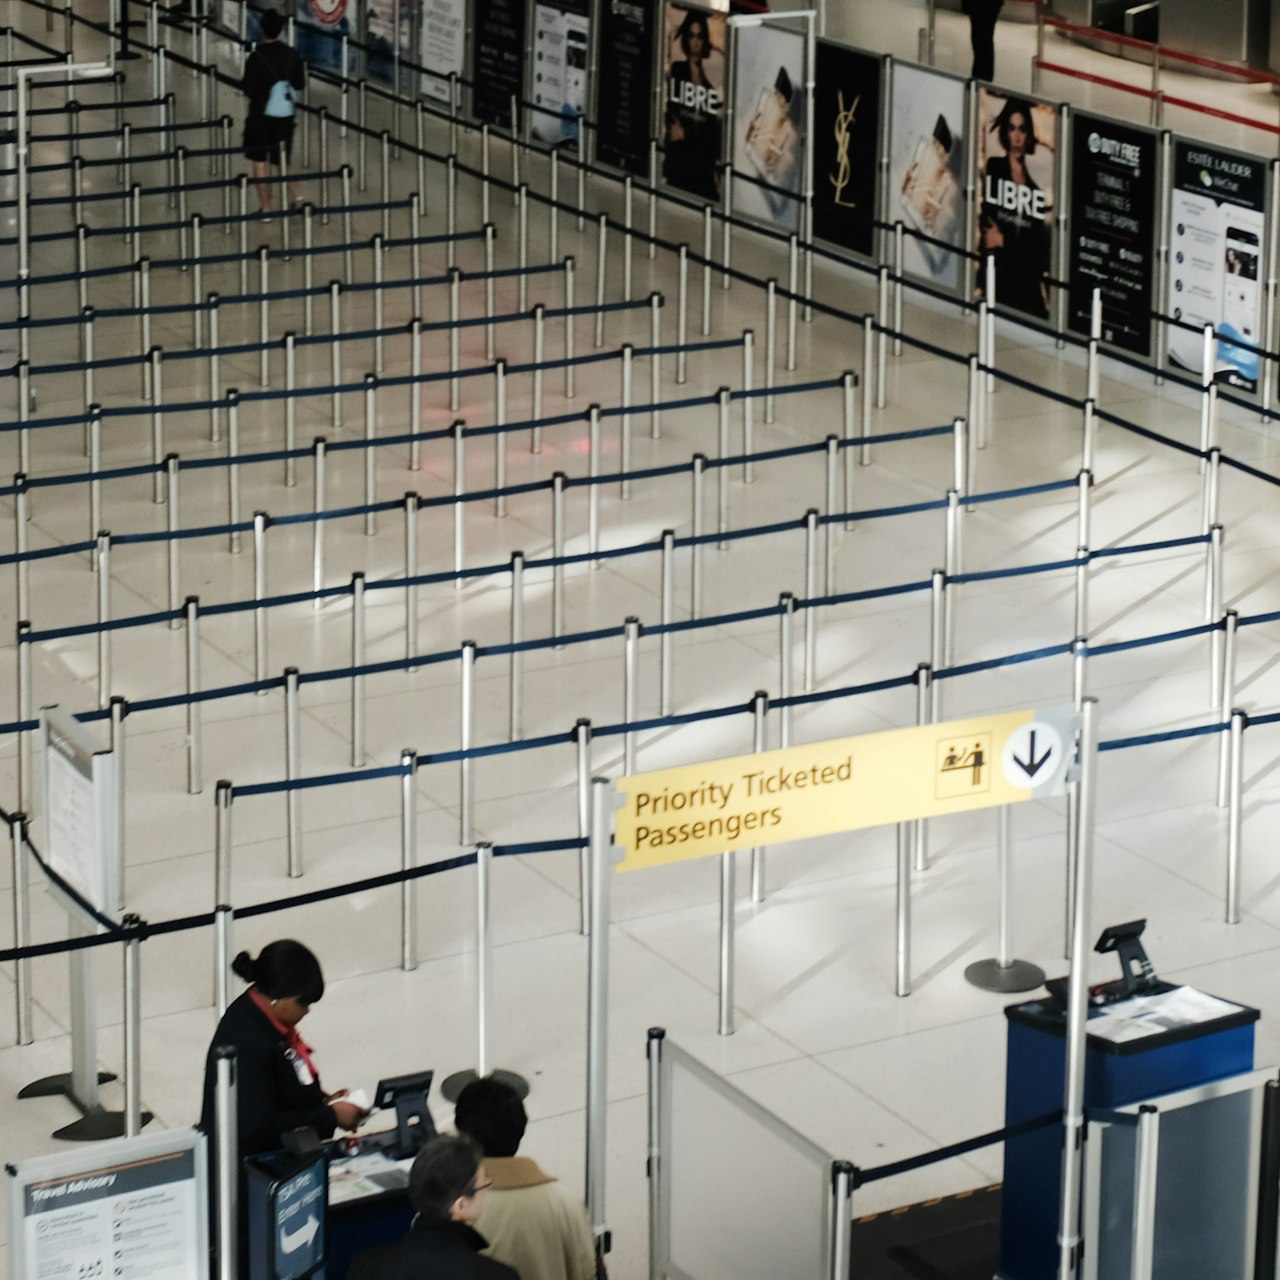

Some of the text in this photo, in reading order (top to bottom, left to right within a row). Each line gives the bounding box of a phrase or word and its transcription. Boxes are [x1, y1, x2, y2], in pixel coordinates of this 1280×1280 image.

[670, 77, 720, 115] LIBRE
[1121, 142, 1141, 163] FREE
[1215, 157, 1252, 179] LAUDER
[985, 175, 1047, 220] LIBRE
[634, 756, 853, 818] Priority Ticketed
[634, 804, 783, 851] Passengers
[31, 1174, 118, 1202] Travel Advisory
